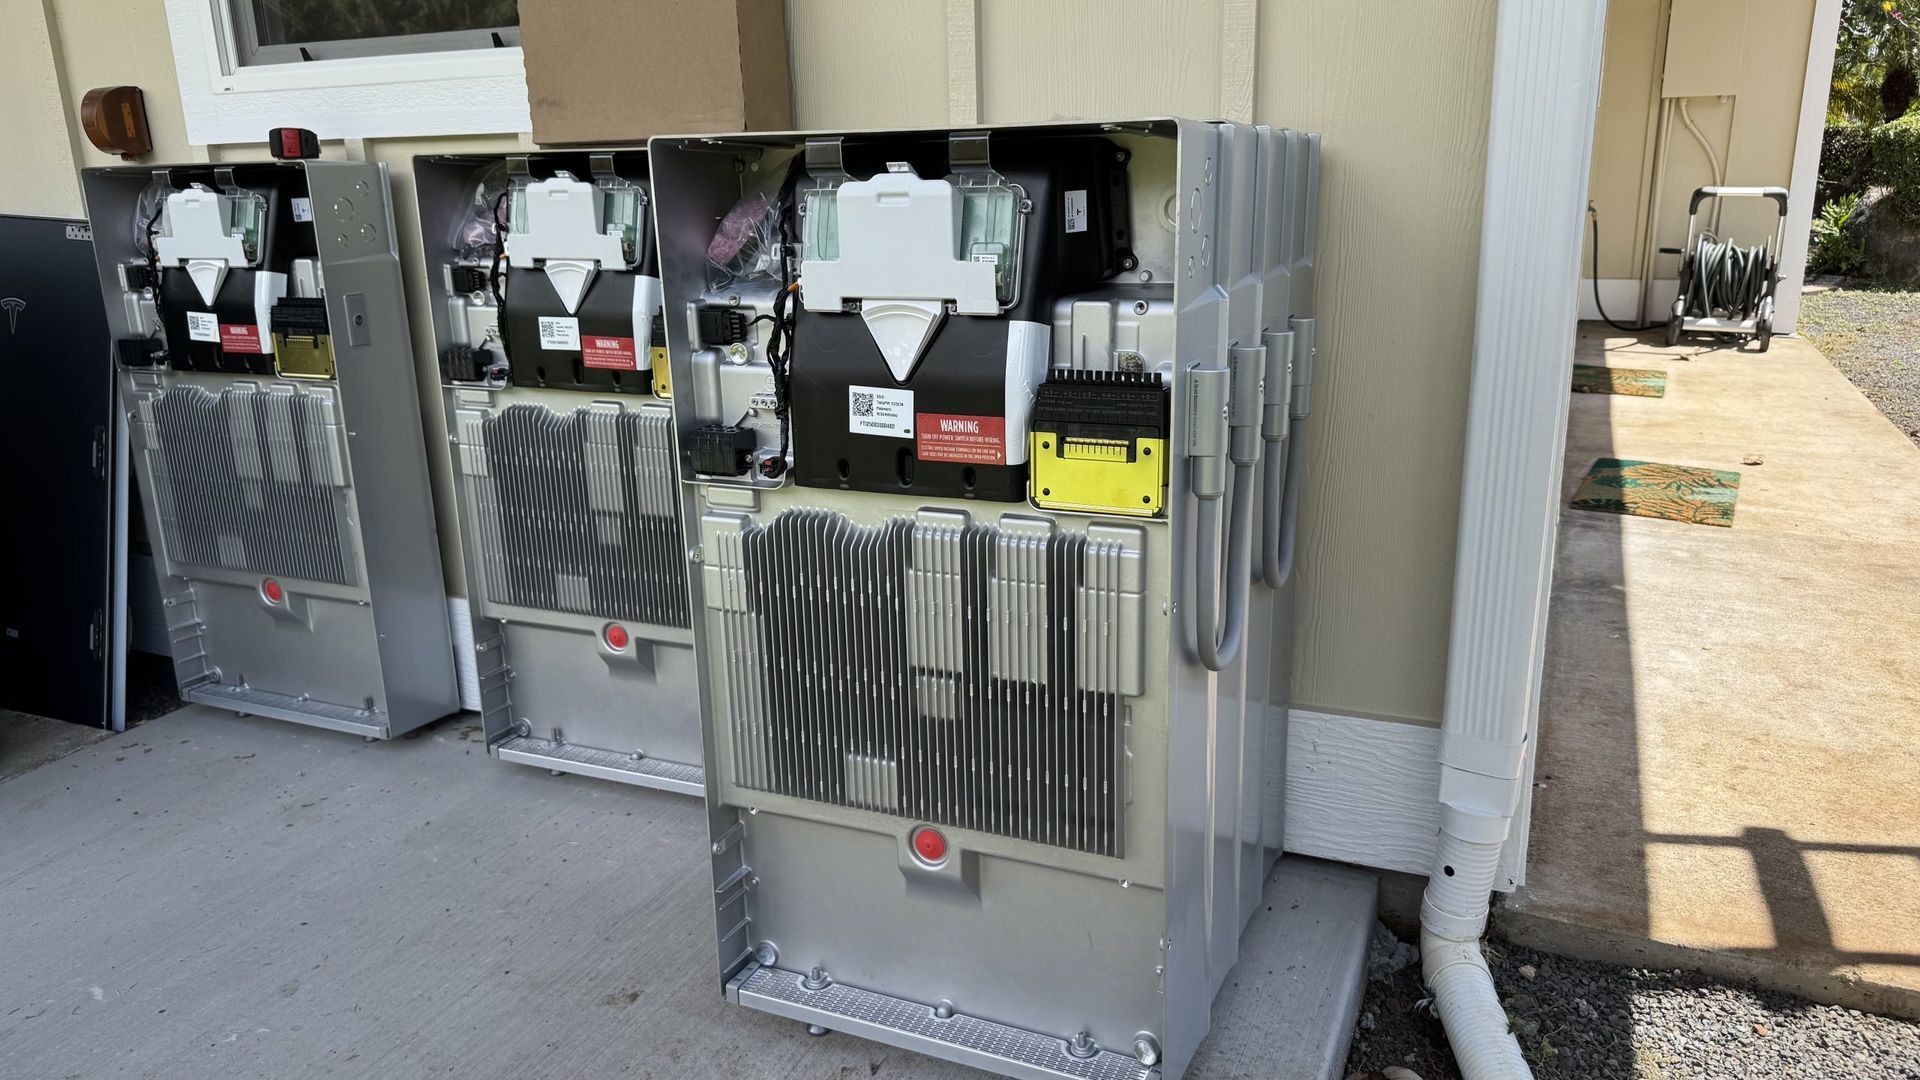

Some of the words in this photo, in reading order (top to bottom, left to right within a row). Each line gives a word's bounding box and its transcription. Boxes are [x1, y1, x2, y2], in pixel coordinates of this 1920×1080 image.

[229, 326, 248, 335] WARNING
[595, 339, 620, 349] WARNING
[939, 418, 979, 433] WARNING
